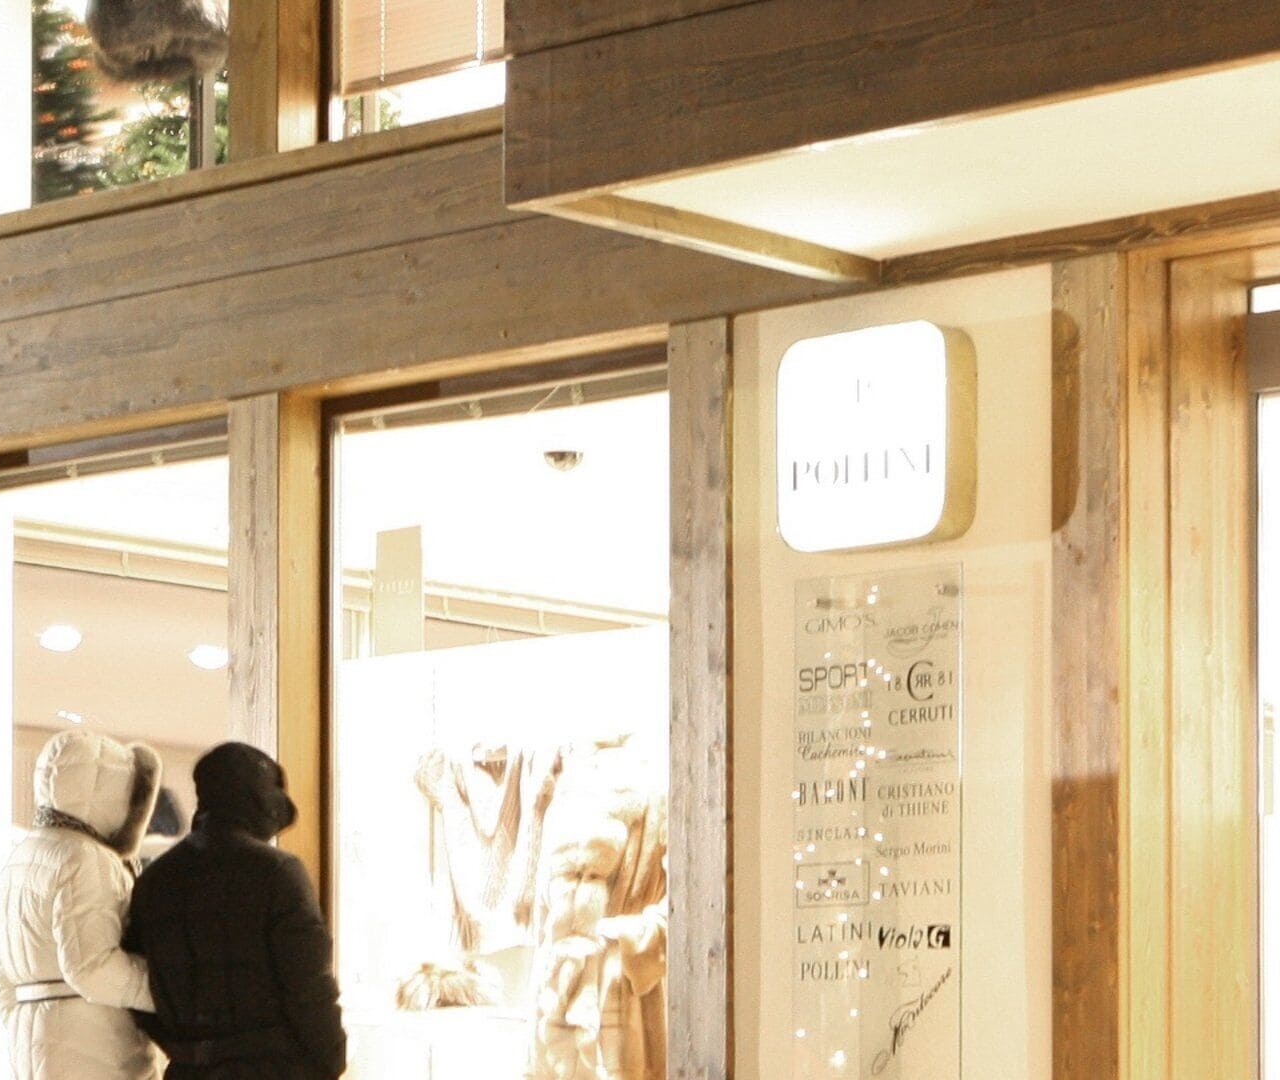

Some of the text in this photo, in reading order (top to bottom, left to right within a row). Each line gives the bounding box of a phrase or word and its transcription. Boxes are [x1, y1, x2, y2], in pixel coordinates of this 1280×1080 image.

[888, 704, 954, 726] CERRUTI
[877, 782, 955, 800] CRISTIANO
[898, 801, 950, 818] THIENE
[797, 922, 872, 944] LATINI
